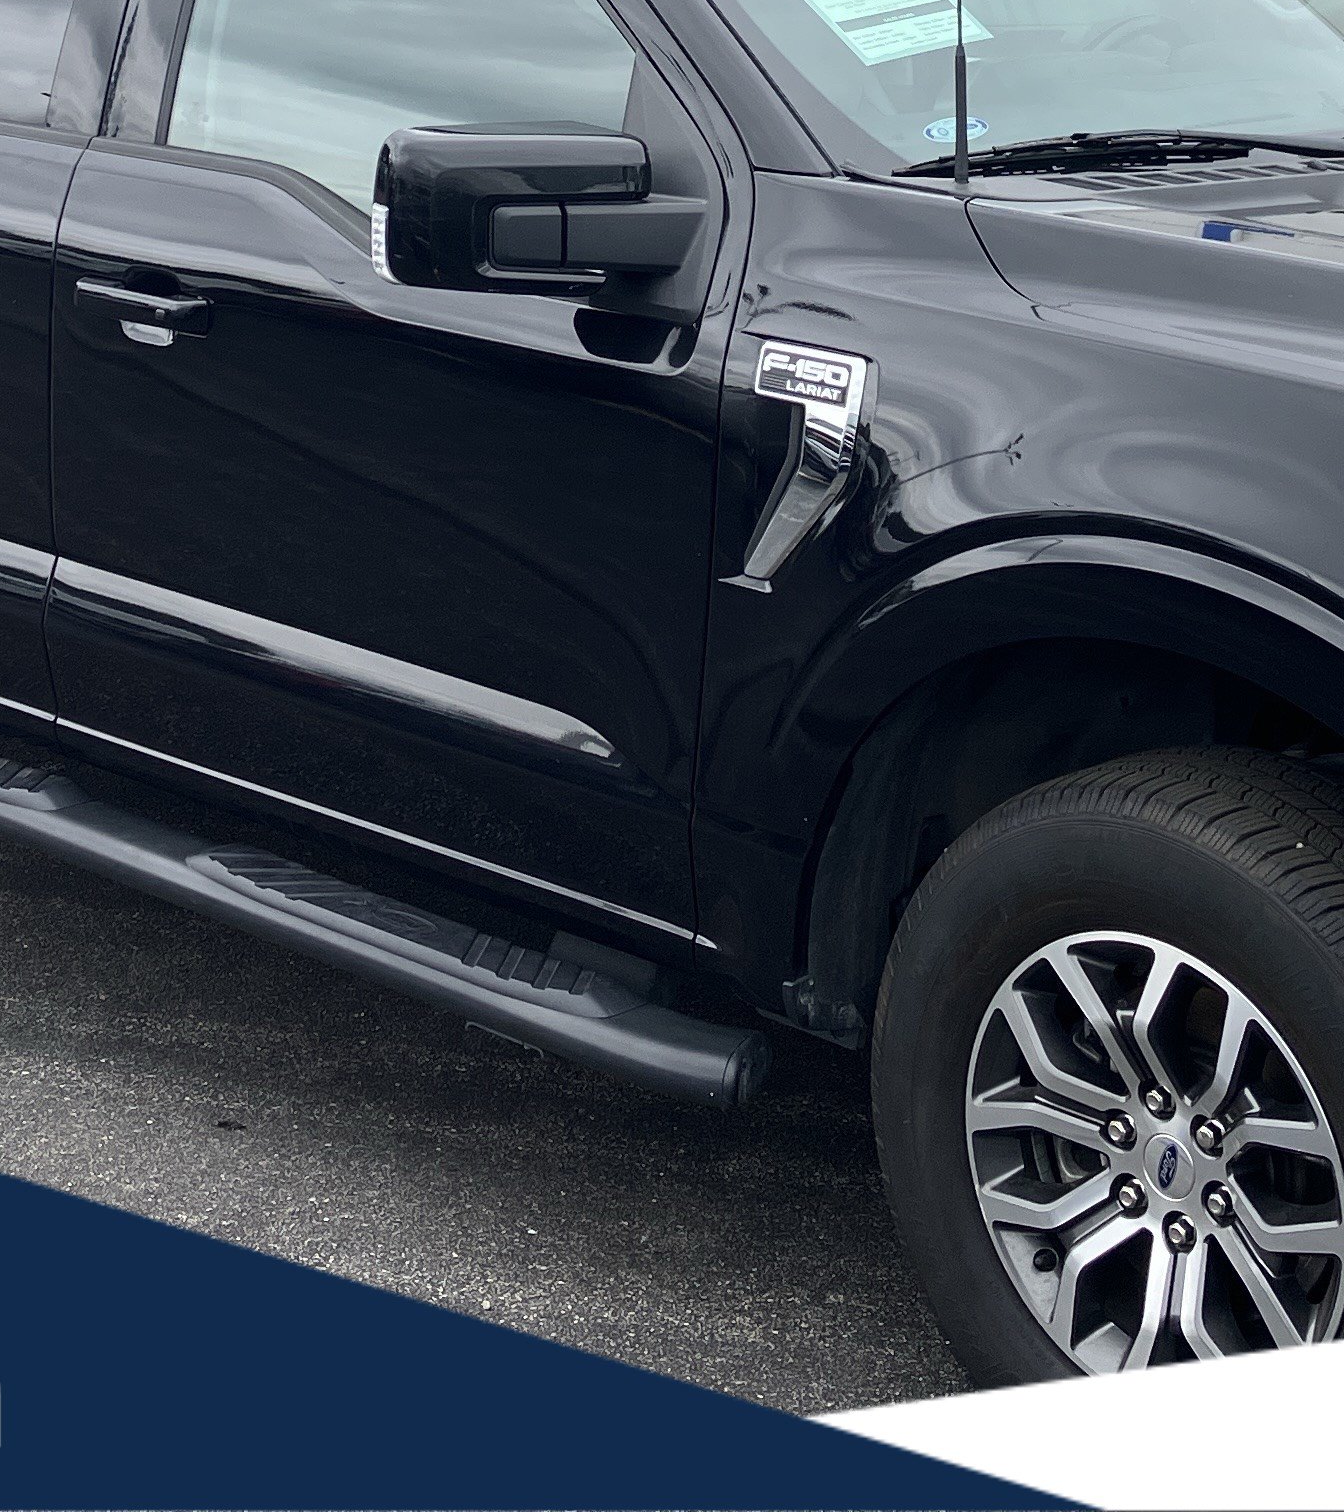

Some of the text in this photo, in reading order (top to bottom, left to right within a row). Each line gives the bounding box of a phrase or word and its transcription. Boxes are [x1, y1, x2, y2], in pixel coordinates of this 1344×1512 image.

[762, 352, 850, 388] F-150
[785, 379, 842, 401] LARIAT
[1159, 1149, 1178, 1184] Ford
